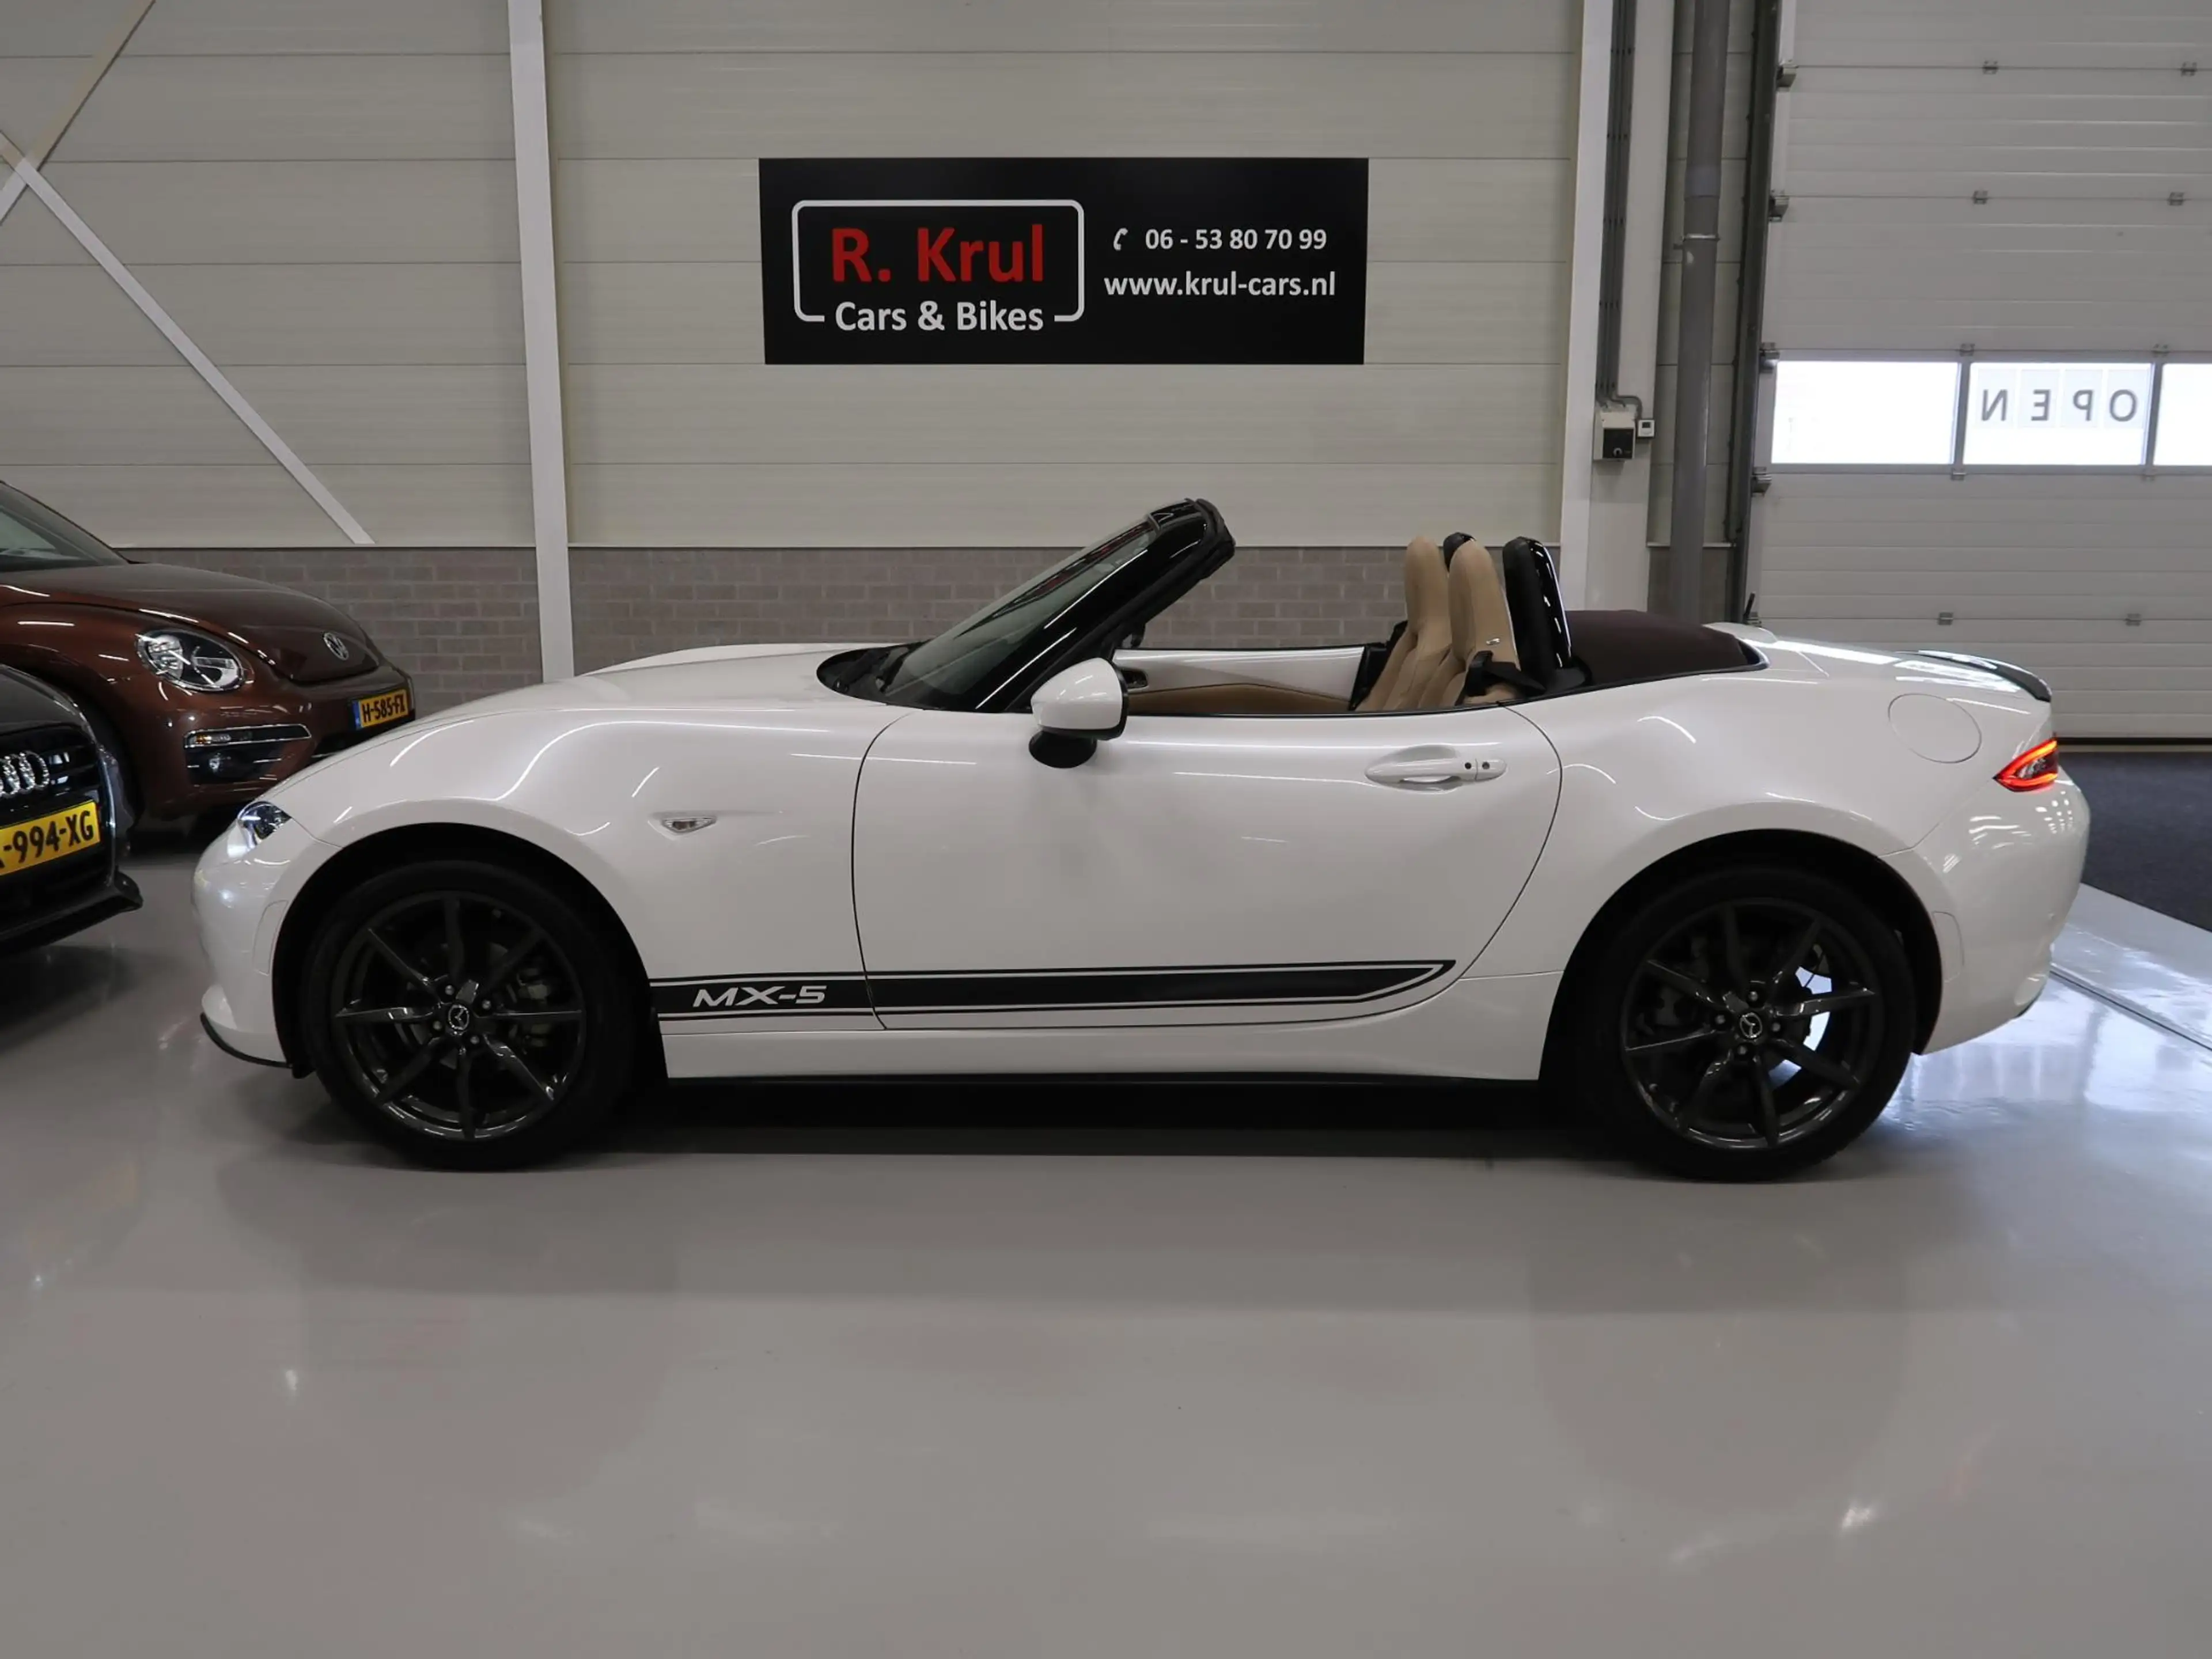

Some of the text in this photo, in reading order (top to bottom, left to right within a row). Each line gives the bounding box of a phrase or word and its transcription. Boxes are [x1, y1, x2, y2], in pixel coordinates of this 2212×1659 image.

[1145, 229, 1173, 249] 06
[1195, 229, 1222, 249] 53
[1229, 229, 1257, 249] 80
[1264, 229, 1293, 249] 70
[1299, 229, 1327, 249] 99
[832, 224, 1044, 283] R. Krul
[1104, 270, 1335, 296] www.krul-cars.nl
[835, 300, 1043, 331] Cars & Bikes
[693, 985, 827, 1007] MX-5
